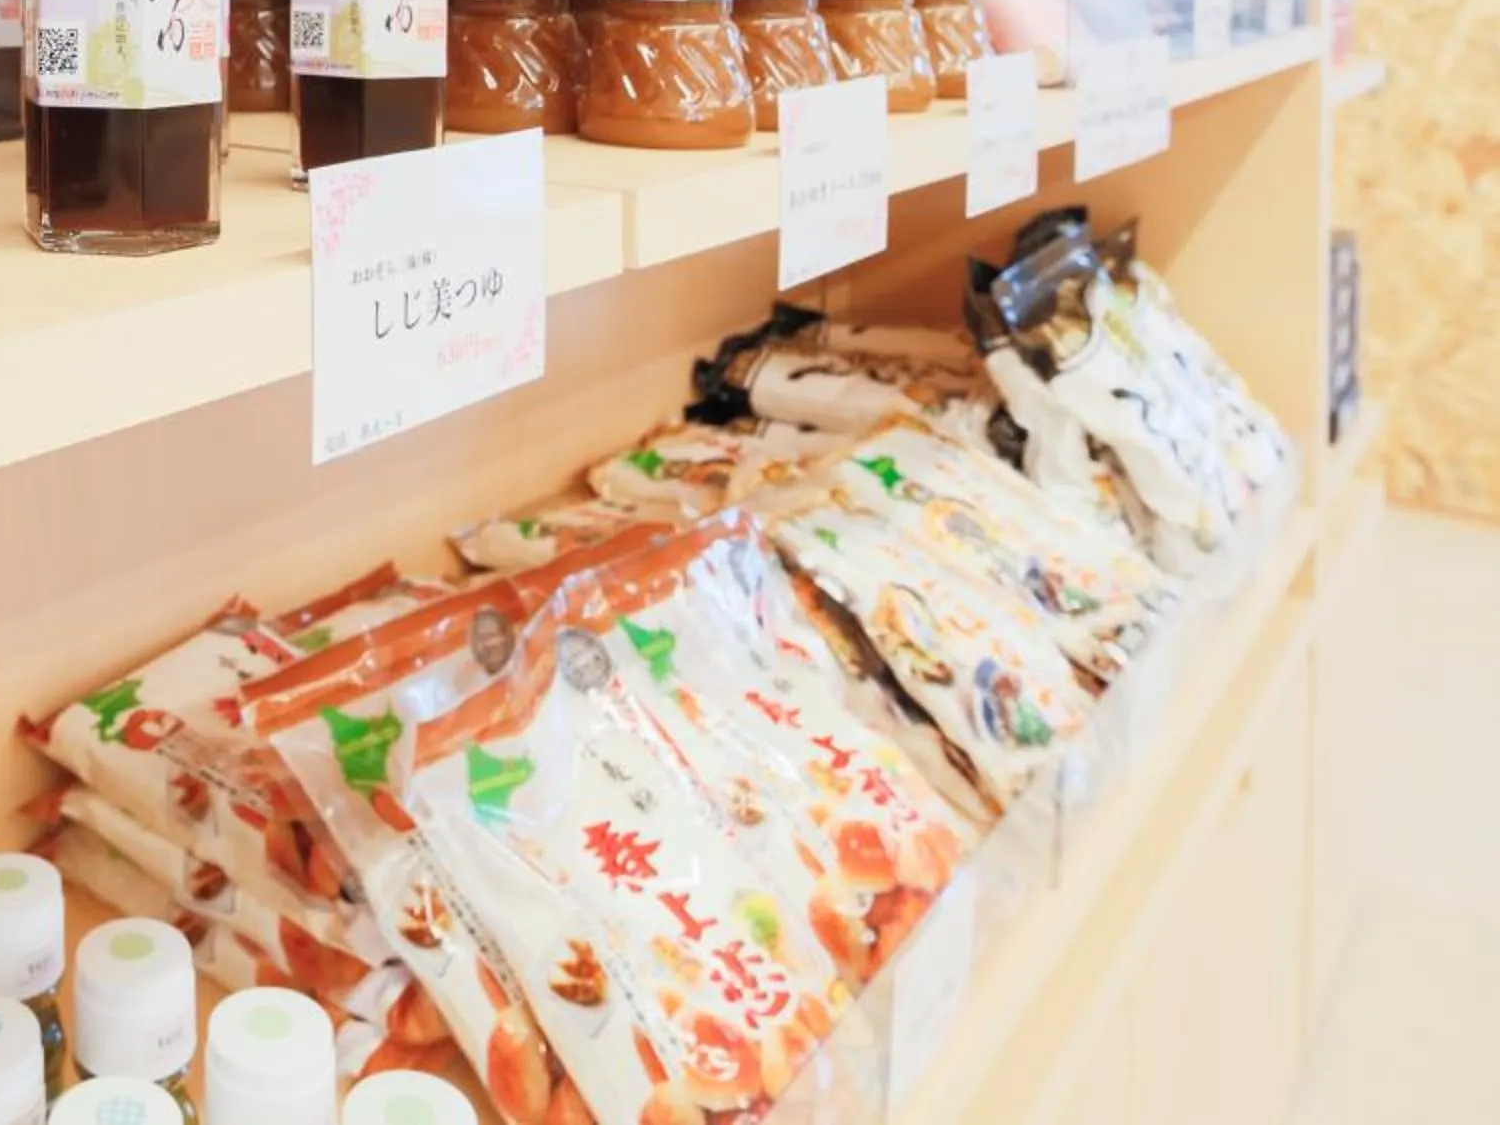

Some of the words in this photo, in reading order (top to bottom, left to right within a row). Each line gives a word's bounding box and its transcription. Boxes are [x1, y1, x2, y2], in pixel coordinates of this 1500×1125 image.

[374, 268, 504, 340] しじ美つゆ
